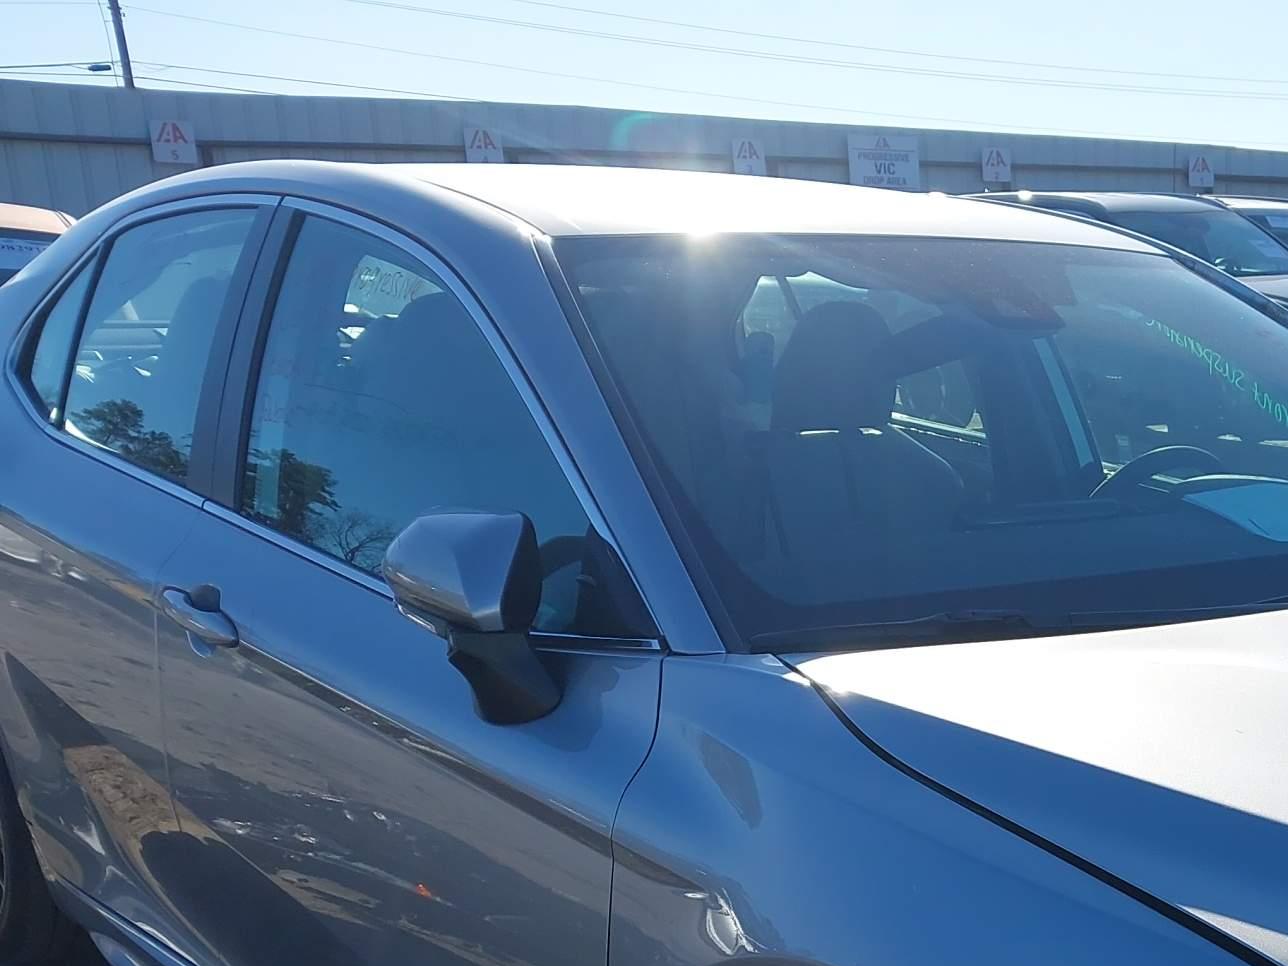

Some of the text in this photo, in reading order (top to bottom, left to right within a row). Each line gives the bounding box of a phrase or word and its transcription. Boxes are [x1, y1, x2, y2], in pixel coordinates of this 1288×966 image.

[170, 149, 180, 161] 5
[857, 151, 910, 163] PROGRESSIVE
[874, 162, 896, 175] VIC
[863, 175, 908, 186] DROP AREA
